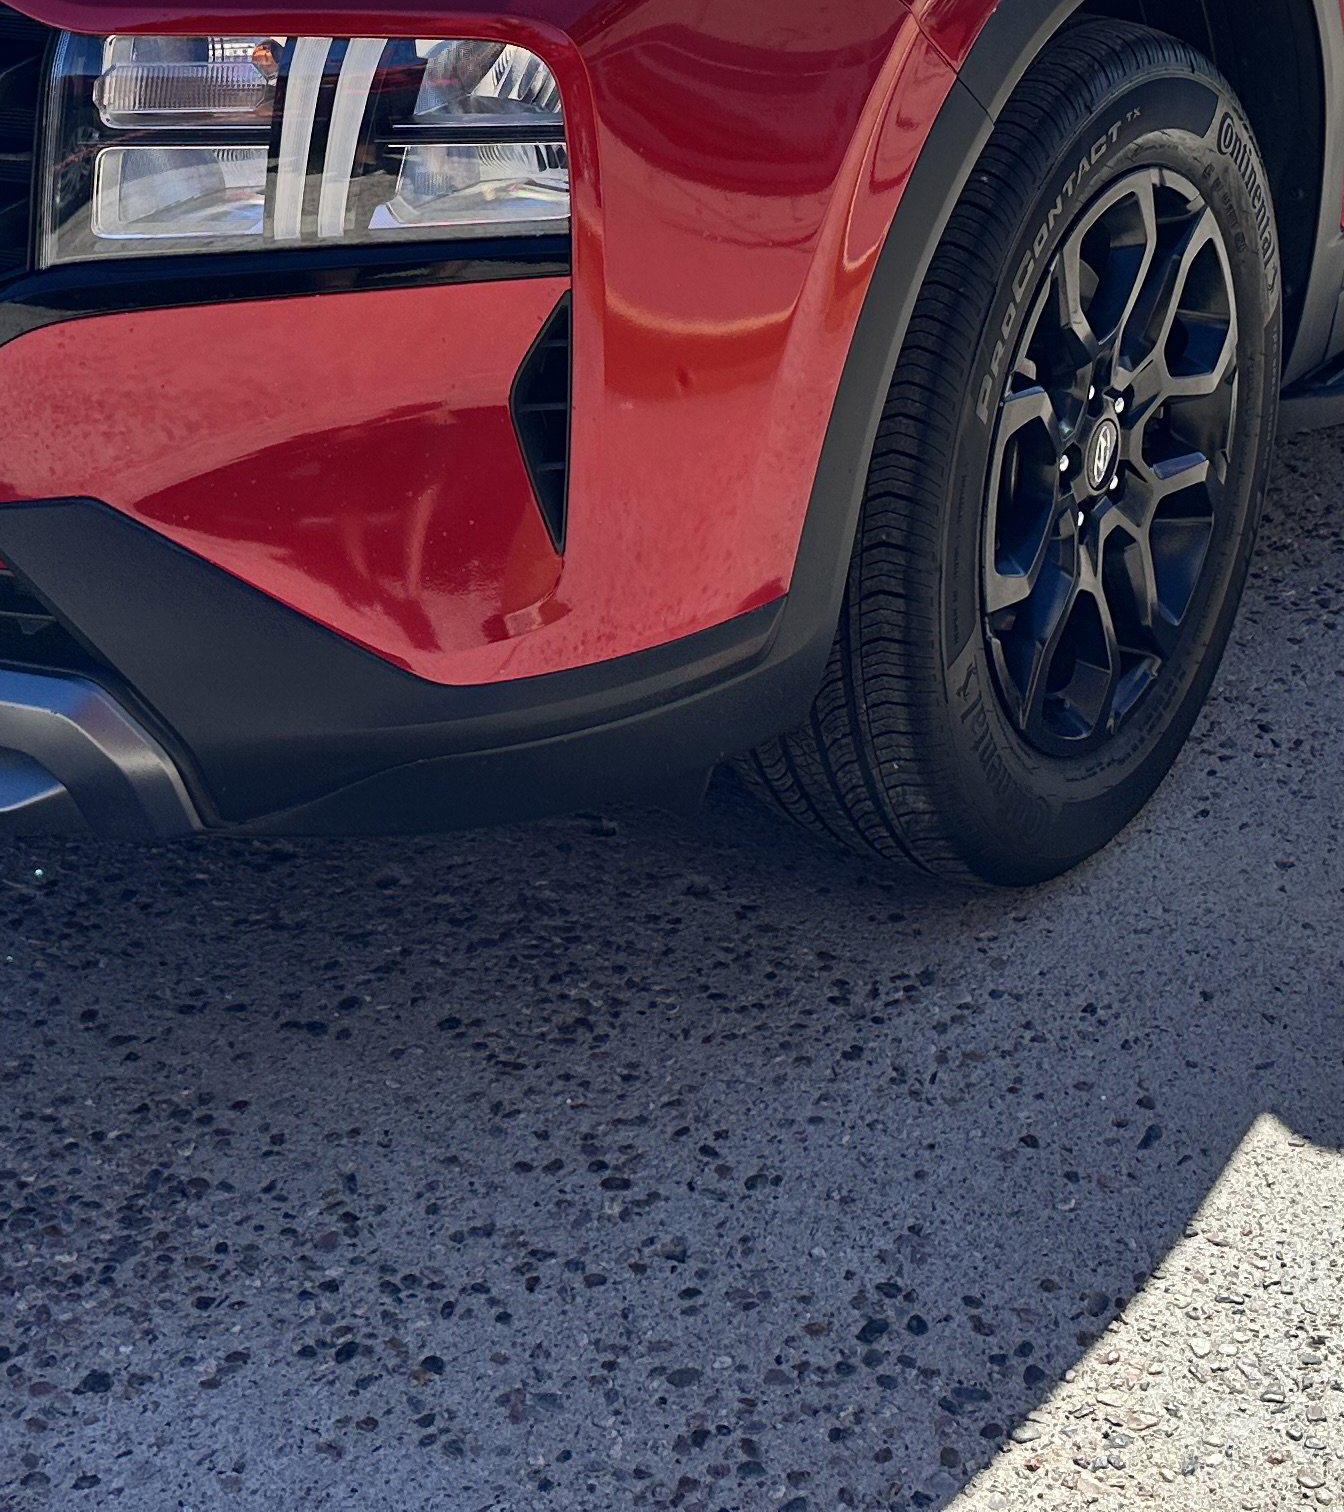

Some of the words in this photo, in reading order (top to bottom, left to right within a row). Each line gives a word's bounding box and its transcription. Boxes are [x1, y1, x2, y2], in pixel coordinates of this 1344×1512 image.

[976, 121, 1121, 425] PROCONTACT
[1126, 107, 1141, 122] TX
[1217, 111, 1276, 270] Continental
